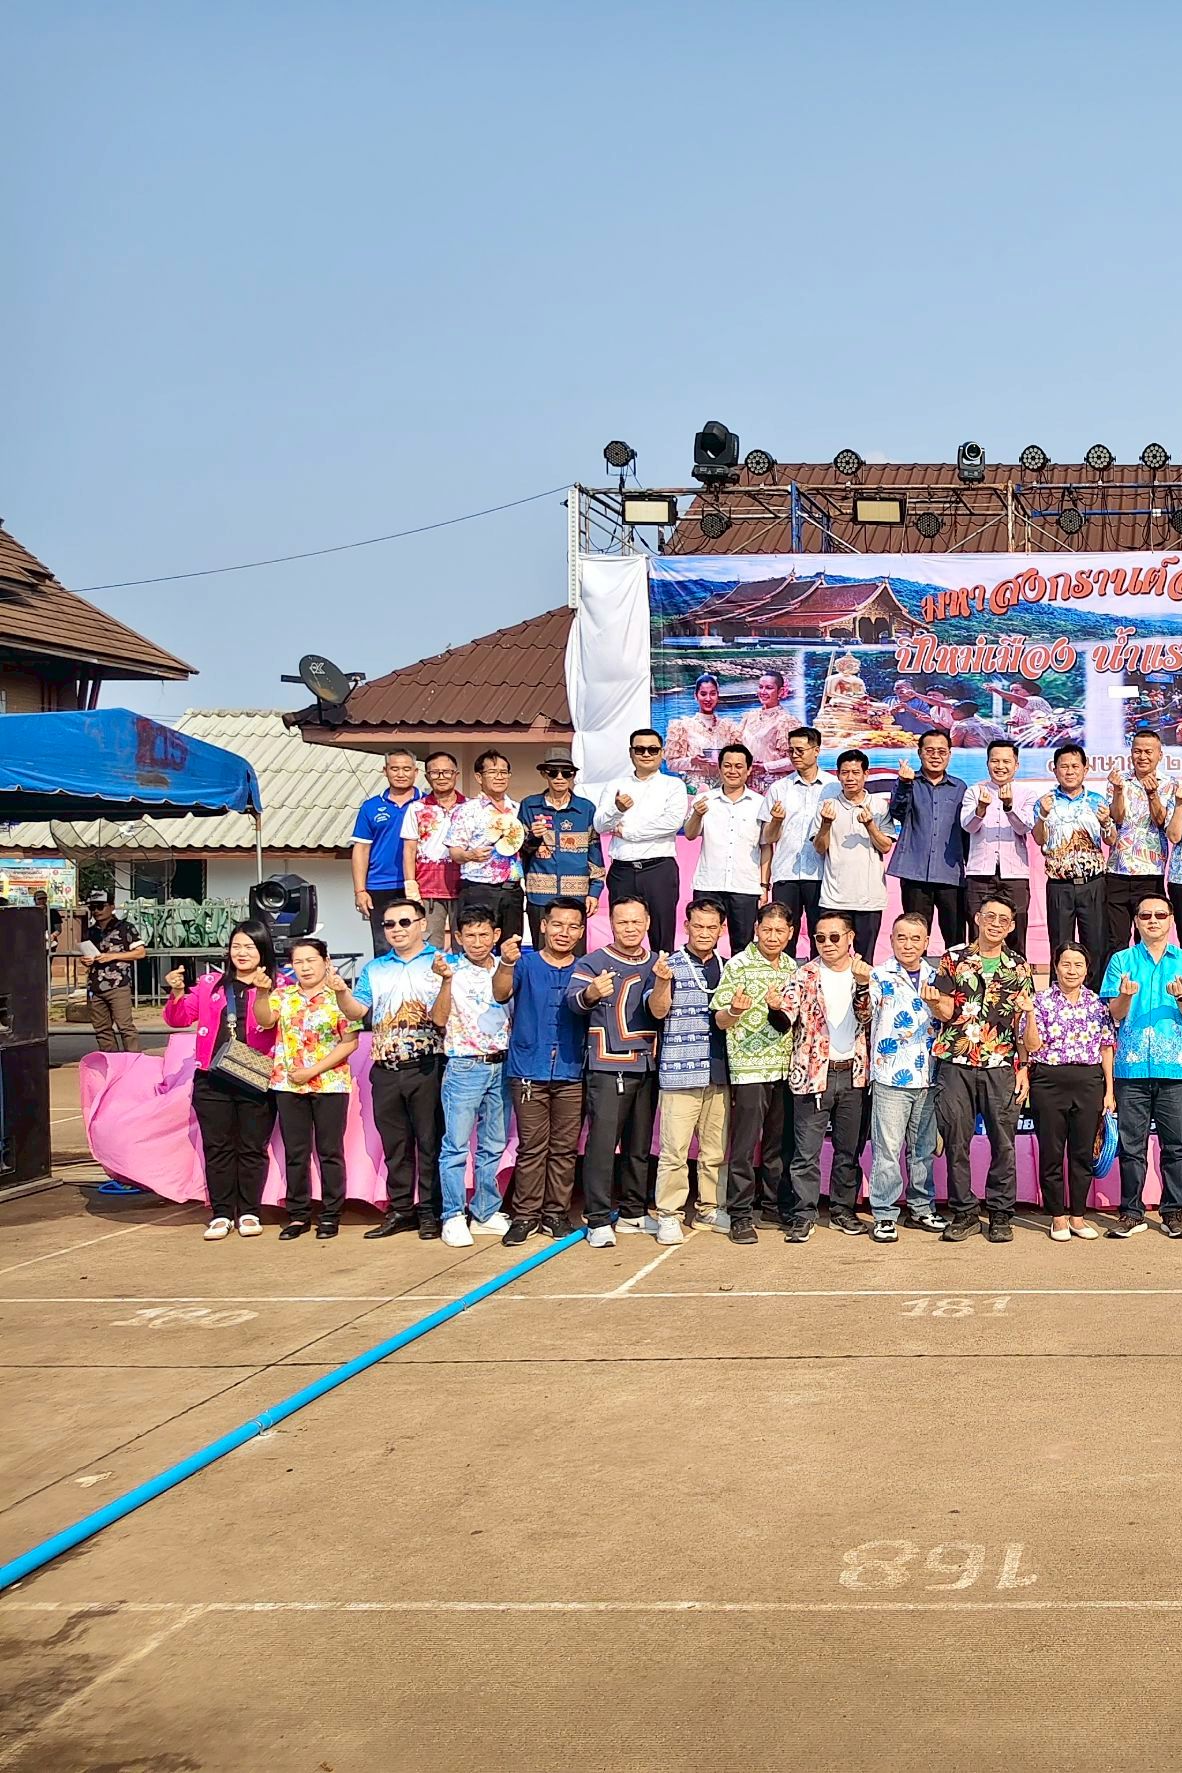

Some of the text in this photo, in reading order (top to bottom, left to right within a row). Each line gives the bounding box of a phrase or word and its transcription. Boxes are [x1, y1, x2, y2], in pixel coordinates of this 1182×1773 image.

[920, 584, 985, 624] มหา
[899, 1295, 1012, 1318] 181
[837, 1539, 1040, 1591] 168
